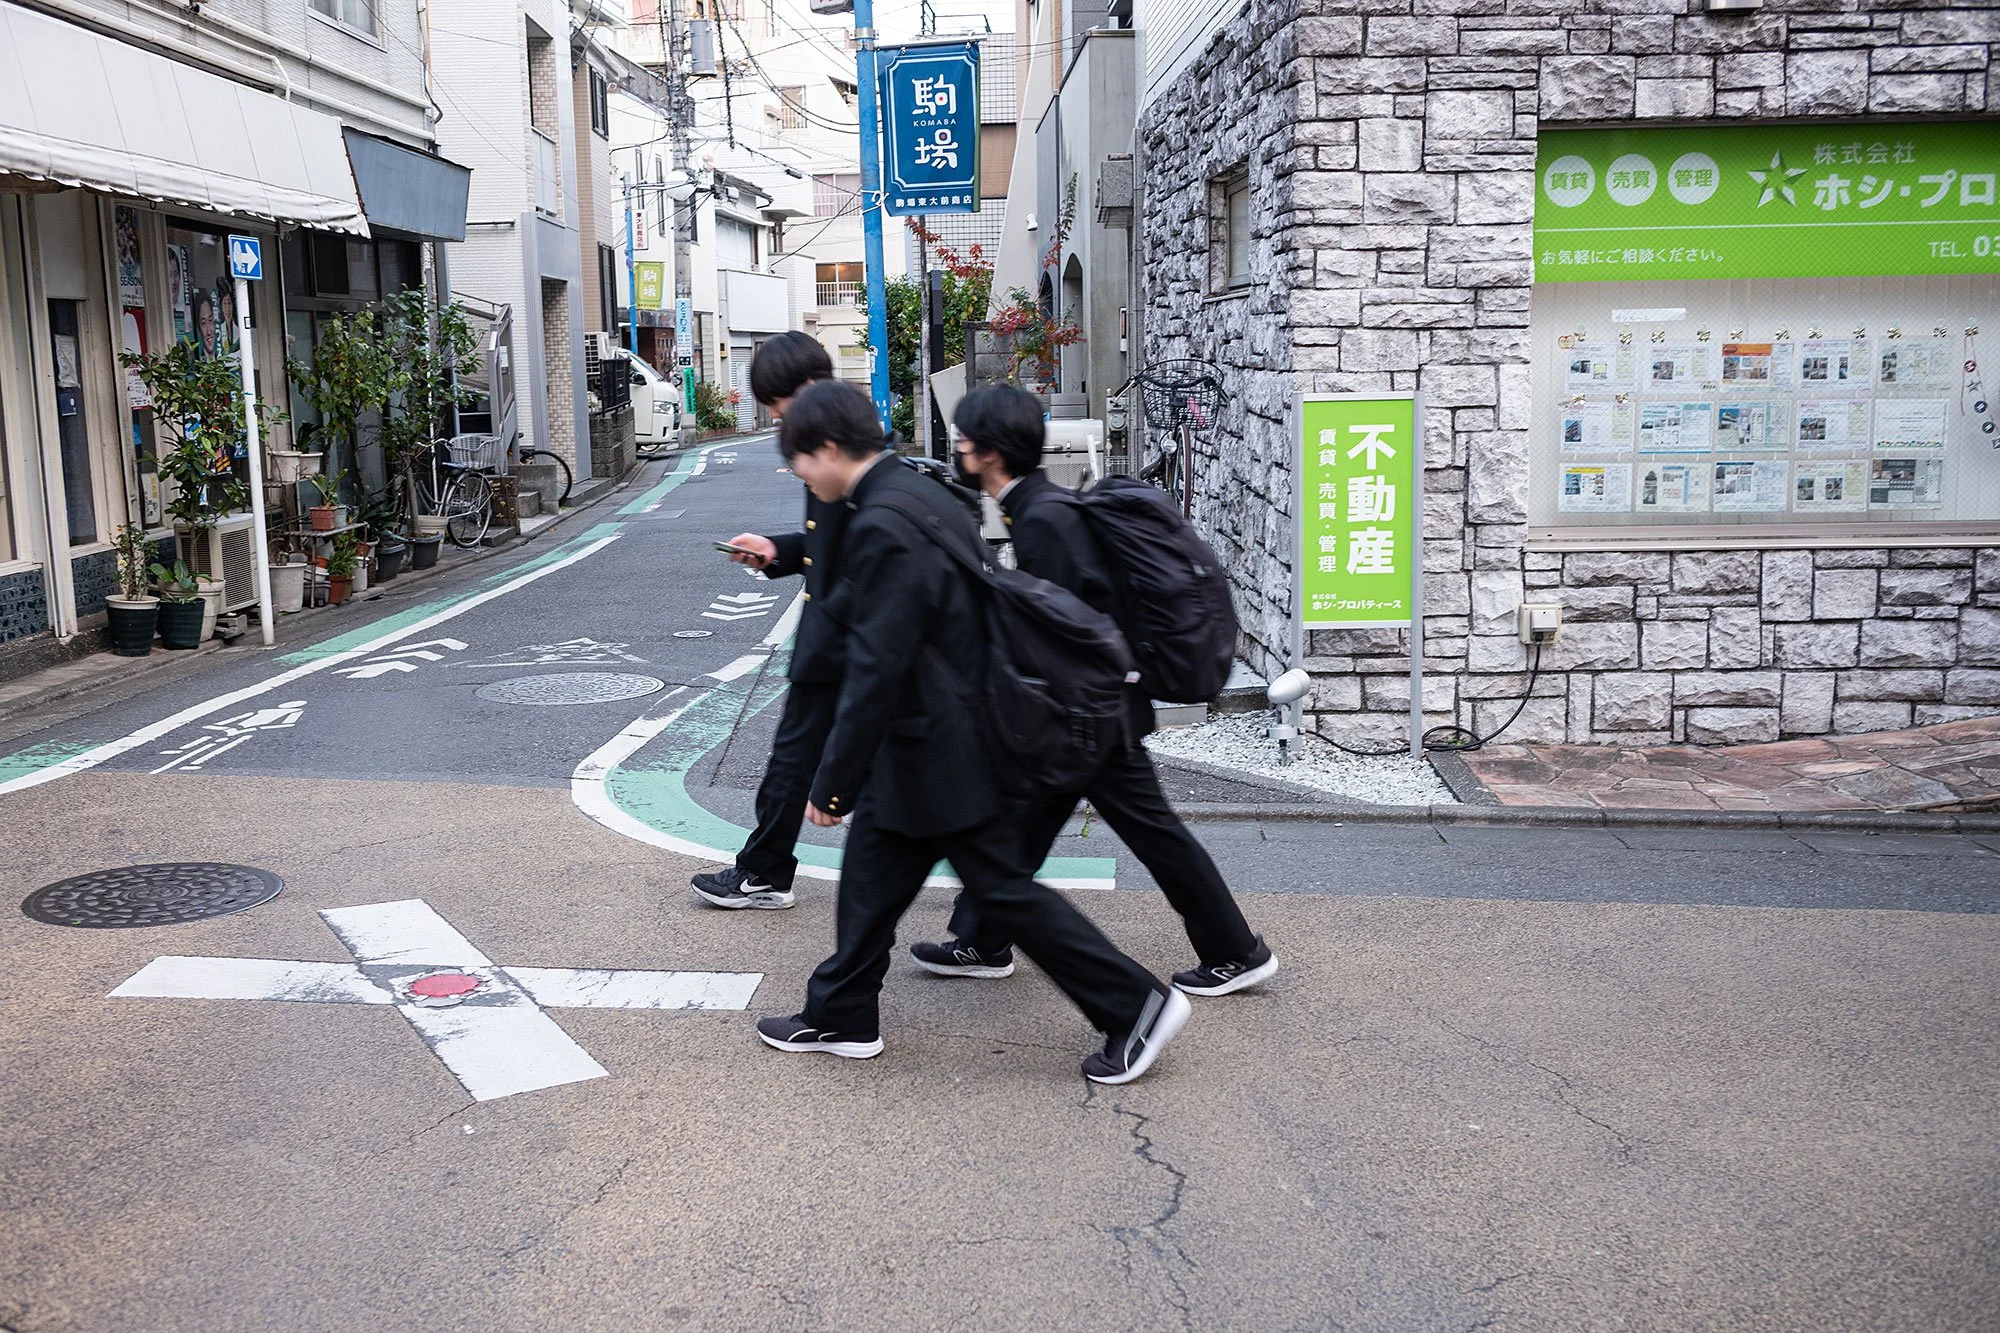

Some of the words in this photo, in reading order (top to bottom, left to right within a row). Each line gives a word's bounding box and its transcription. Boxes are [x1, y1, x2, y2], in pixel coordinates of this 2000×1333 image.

[912, 73, 958, 169] 駒場
[913, 118, 957, 127] KOMABA
[1813, 141, 1916, 165] 株式会社
[1550, 172, 1588, 190] 賃貸
[1612, 170, 1650, 189] 売買
[1674, 168, 1713, 188] 管理
[1813, 169, 1996, 211] ホシ・プロ
[1541, 246, 1724, 265] お気軽にご相談ください。
[1928, 241, 1967, 257] TEL.
[680, 302, 688, 332] KUMON
[1318, 428, 1337, 573] 賃貸・売買・管理
[1346, 423, 1397, 575] 不動産
